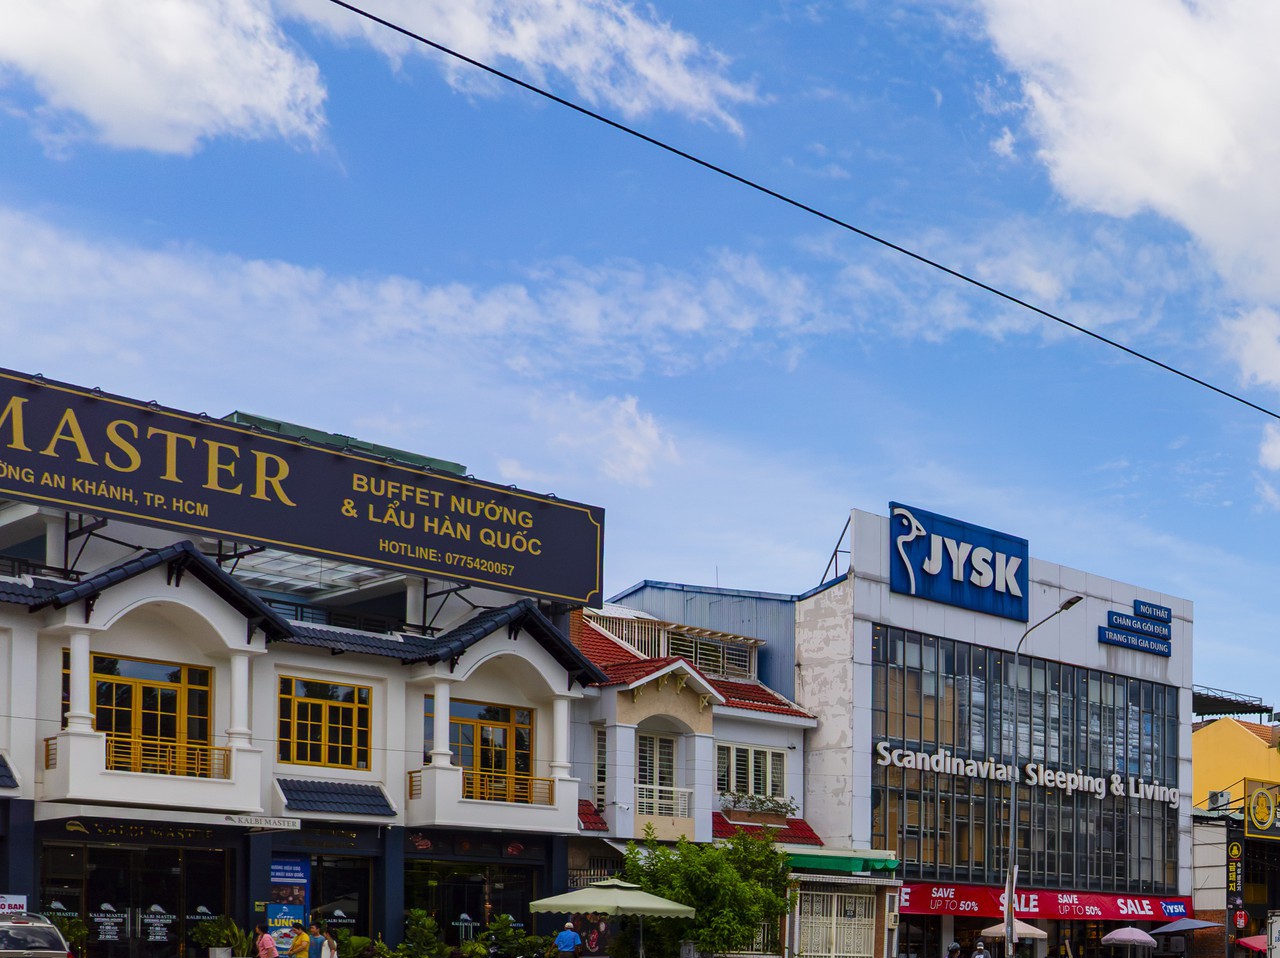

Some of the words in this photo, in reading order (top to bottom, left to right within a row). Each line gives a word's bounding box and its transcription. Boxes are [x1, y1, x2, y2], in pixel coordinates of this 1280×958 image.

[40, 474, 66, 490] AN
[71, 477, 139, 505] KHÁNH,
[143, 491, 168, 510] TP.
[172, 499, 209, 517] HCM
[353, 473, 444, 509] BUFFET
[451, 494, 534, 529] NƯỚNG
[341, 498, 358, 518] &
[368, 499, 415, 530] LẨU
[424, 514, 471, 542] HÀN
[479, 527, 543, 556] QUỐC
[379, 538, 442, 563] HOTLINE:
[445, 552, 515, 577] 0775420057
[923, 533, 1023, 598] JYSK
[1132, 620, 1141, 630] GA
[1105, 630, 1127, 643] TRANG
[1138, 640, 1149, 649] GIA
[876, 741, 1020, 783] Scandinavian
[1025, 762, 1106, 799] Sleeping
[1110, 773, 1125, 797] &
[1128, 776, 1180, 809] Living
[237, 816, 263, 827] KALBI
[264, 818, 297, 829] MASTER
[1228, 862, 1236, 892] 금돼지
[931, 887, 955, 900] SAVE
[1057, 894, 1078, 904] SAVE
[930, 899, 941, 909] UP
[941, 899, 957, 911] TO
[959, 902, 979, 912] 50%
[1058, 905, 1069, 915] UP
[1070, 905, 1085, 916] TO
[1085, 905, 1102, 916] 50%
[1117, 898, 1154, 916] SALE
